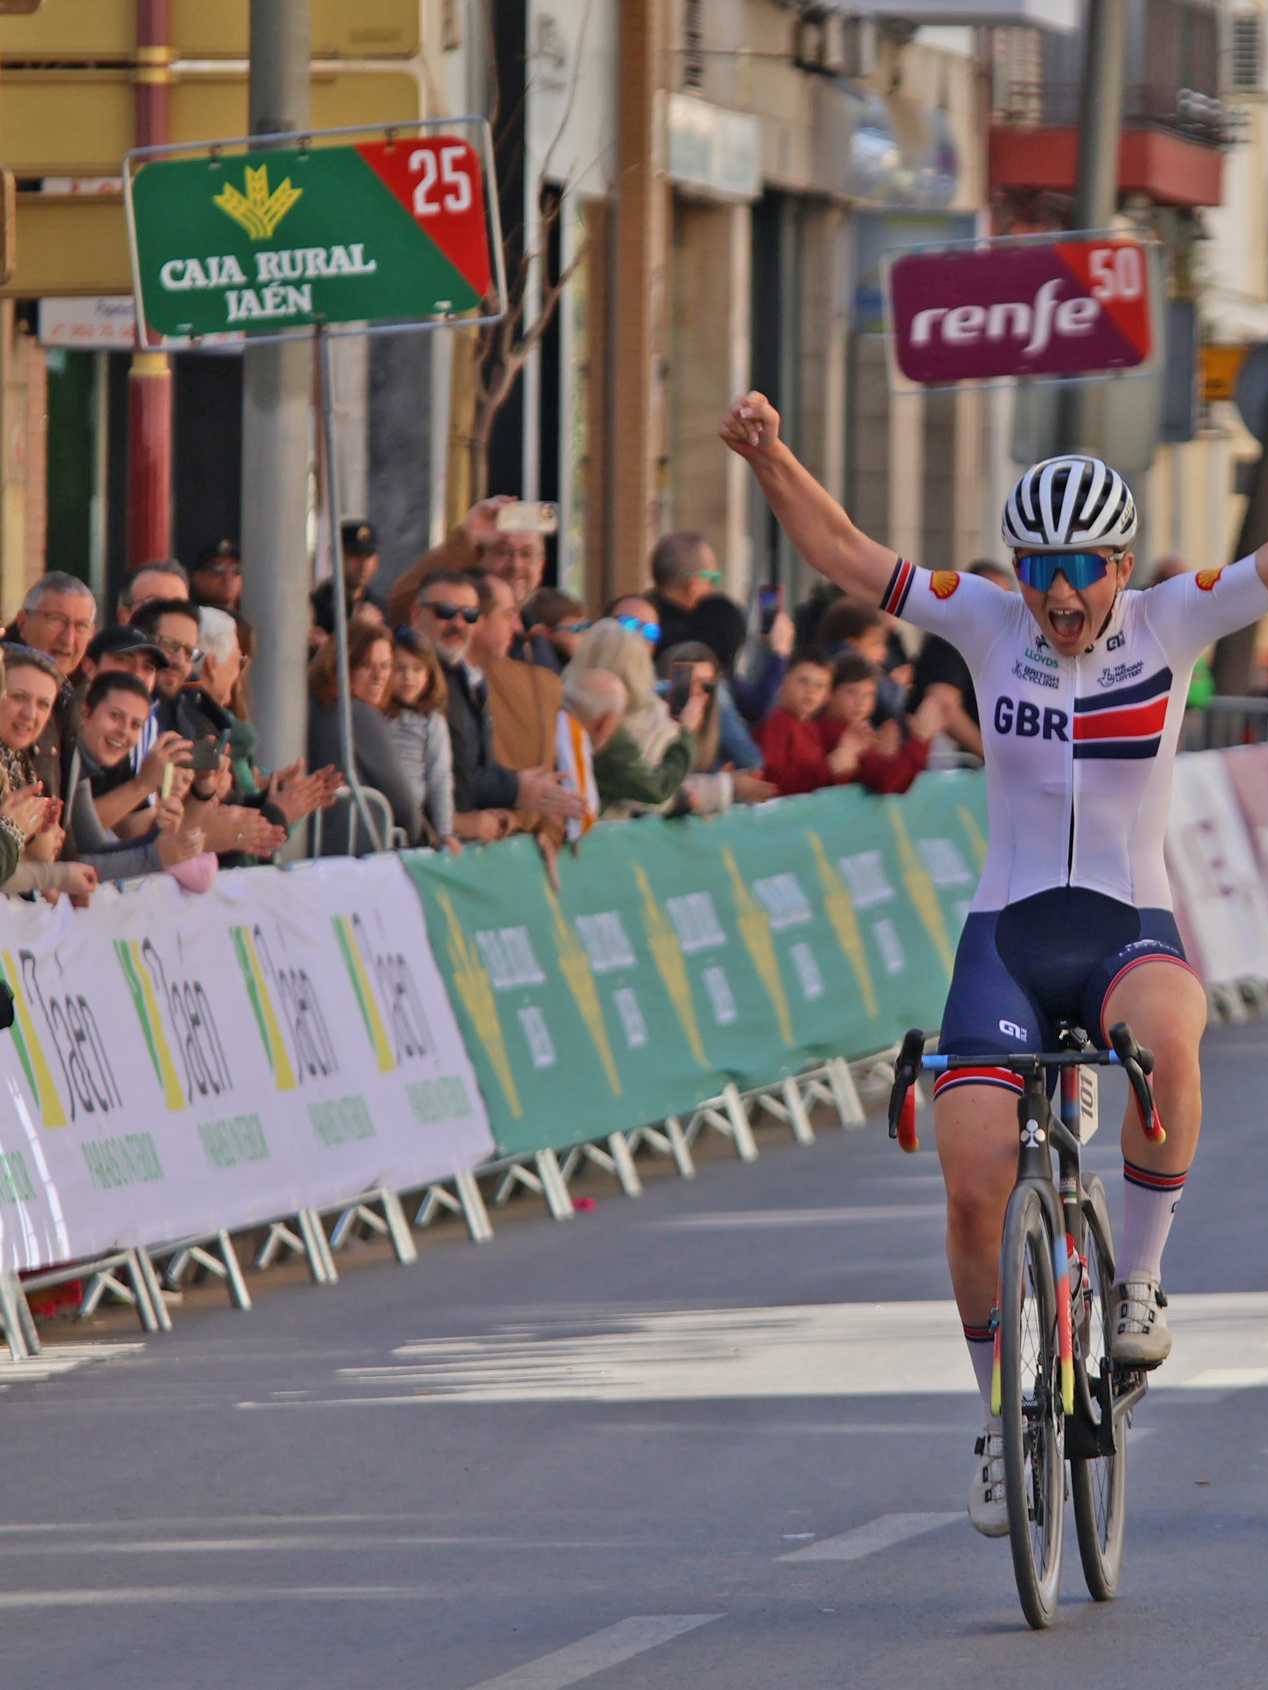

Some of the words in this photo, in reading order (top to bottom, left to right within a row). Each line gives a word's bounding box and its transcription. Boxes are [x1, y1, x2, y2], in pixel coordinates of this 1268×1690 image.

[409, 145, 473, 217] 25
[160, 254, 248, 291] CAJA
[255, 243, 377, 282] RURAL
[1089, 245, 1142, 300] 50
[224, 281, 313, 322] JAÉN
[908, 278, 1099, 353] renfe
[1023, 666, 1060, 683] BRITISH
[1024, 647, 1059, 668] LLOYDS
[1115, 660, 1144, 676] NATIONAL
[1115, 668, 1143, 683] LOTTERY
[1022, 674, 1060, 690] CYCLING
[994, 695, 1070, 742] GBR
